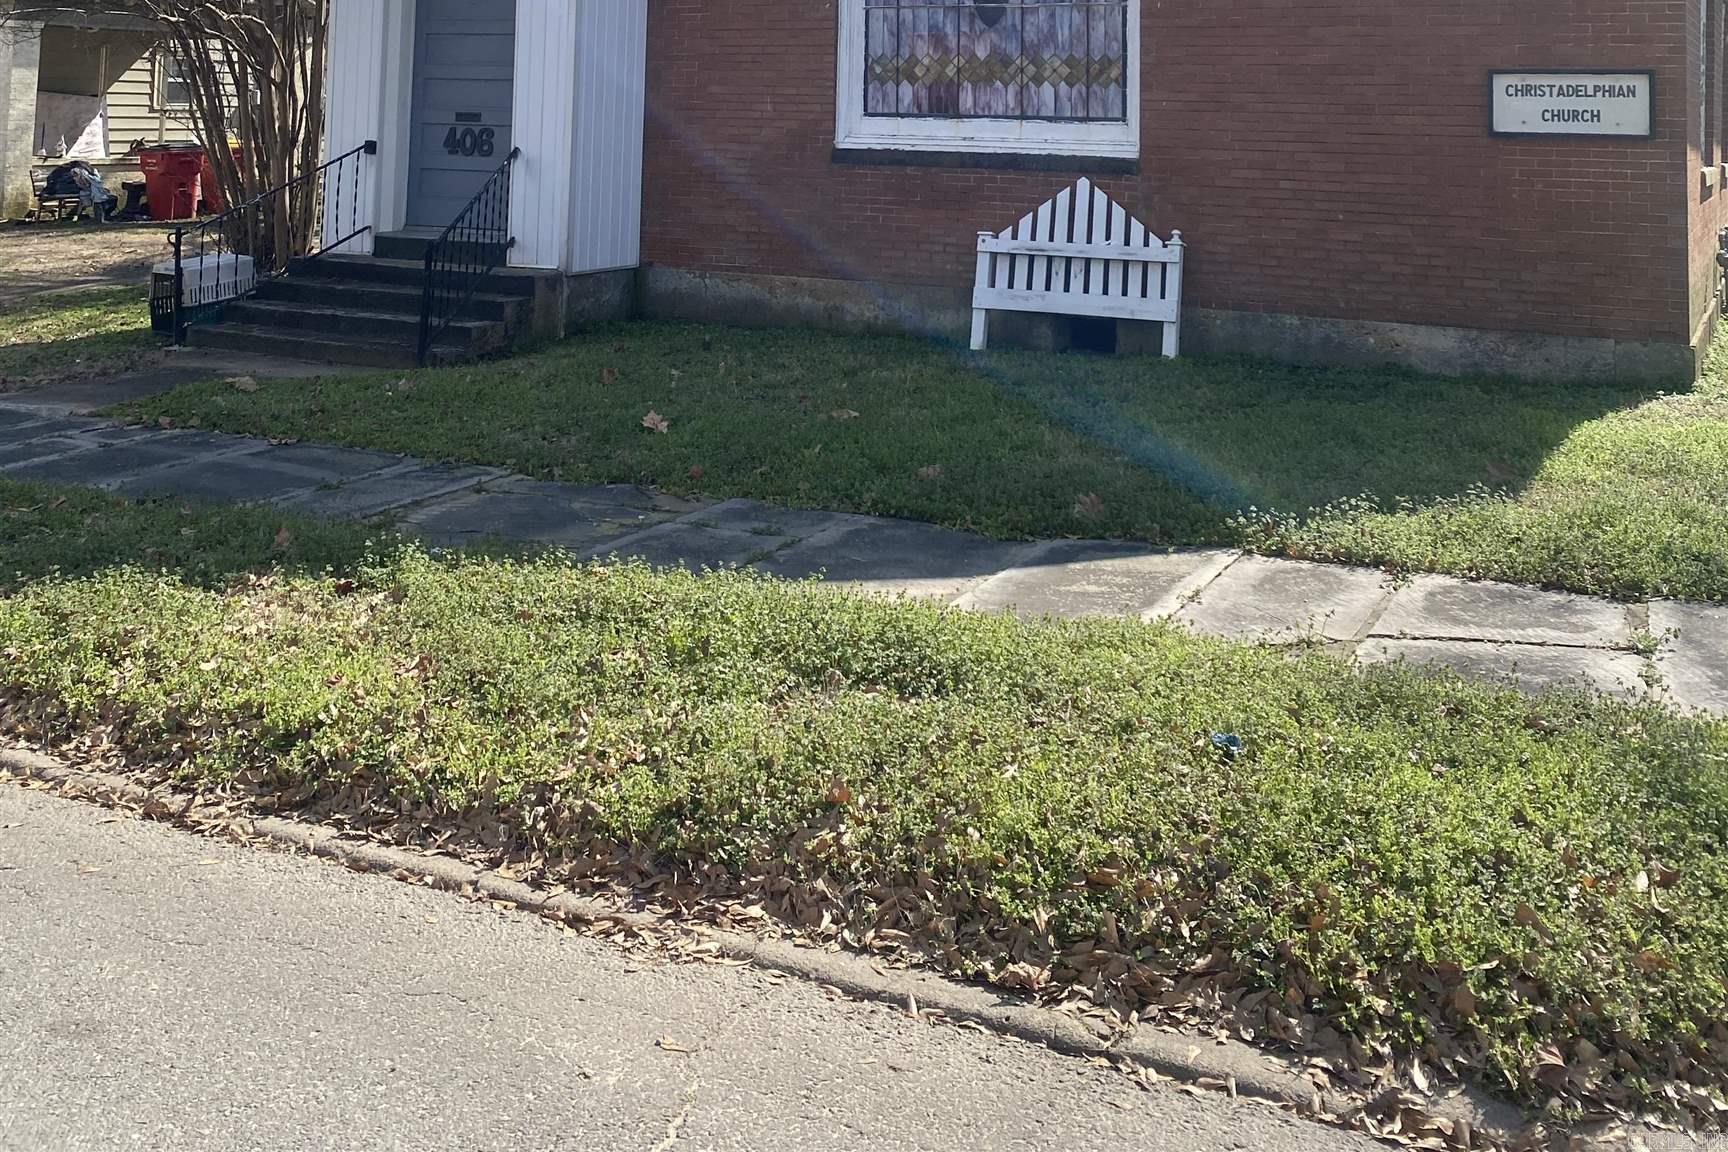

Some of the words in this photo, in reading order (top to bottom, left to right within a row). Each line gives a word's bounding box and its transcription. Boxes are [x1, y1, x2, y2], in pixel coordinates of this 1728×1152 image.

[1505, 84, 1637, 98] CHRISTADELPHIAN
[1541, 109, 1601, 123] CHURCH
[443, 127, 495, 157] 406
